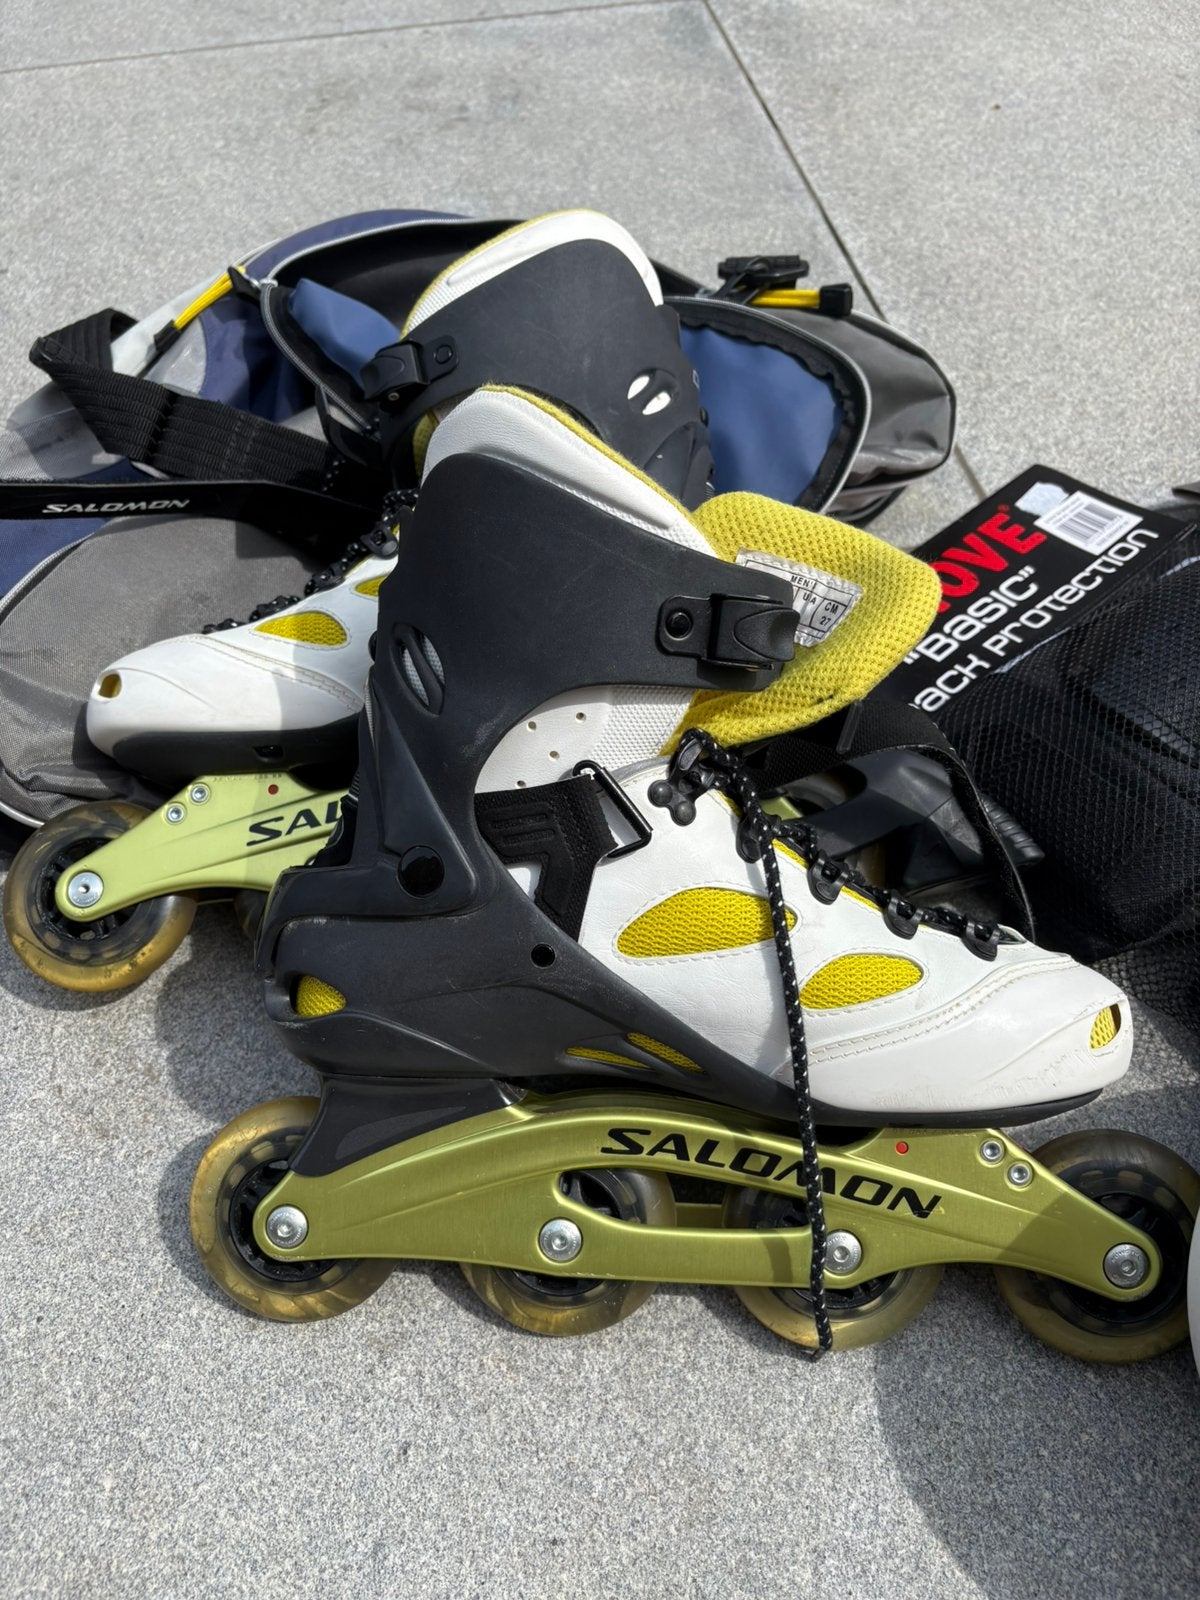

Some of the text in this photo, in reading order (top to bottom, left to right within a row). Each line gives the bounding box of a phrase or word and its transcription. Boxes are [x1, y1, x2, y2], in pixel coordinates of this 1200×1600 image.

[42, 499, 190, 514] SALOMON
[928, 513, 1047, 613] OVE
[824, 602, 839, 615] CM
[819, 616, 832, 627] 27
[600, 1127, 942, 1220] SALOMON
